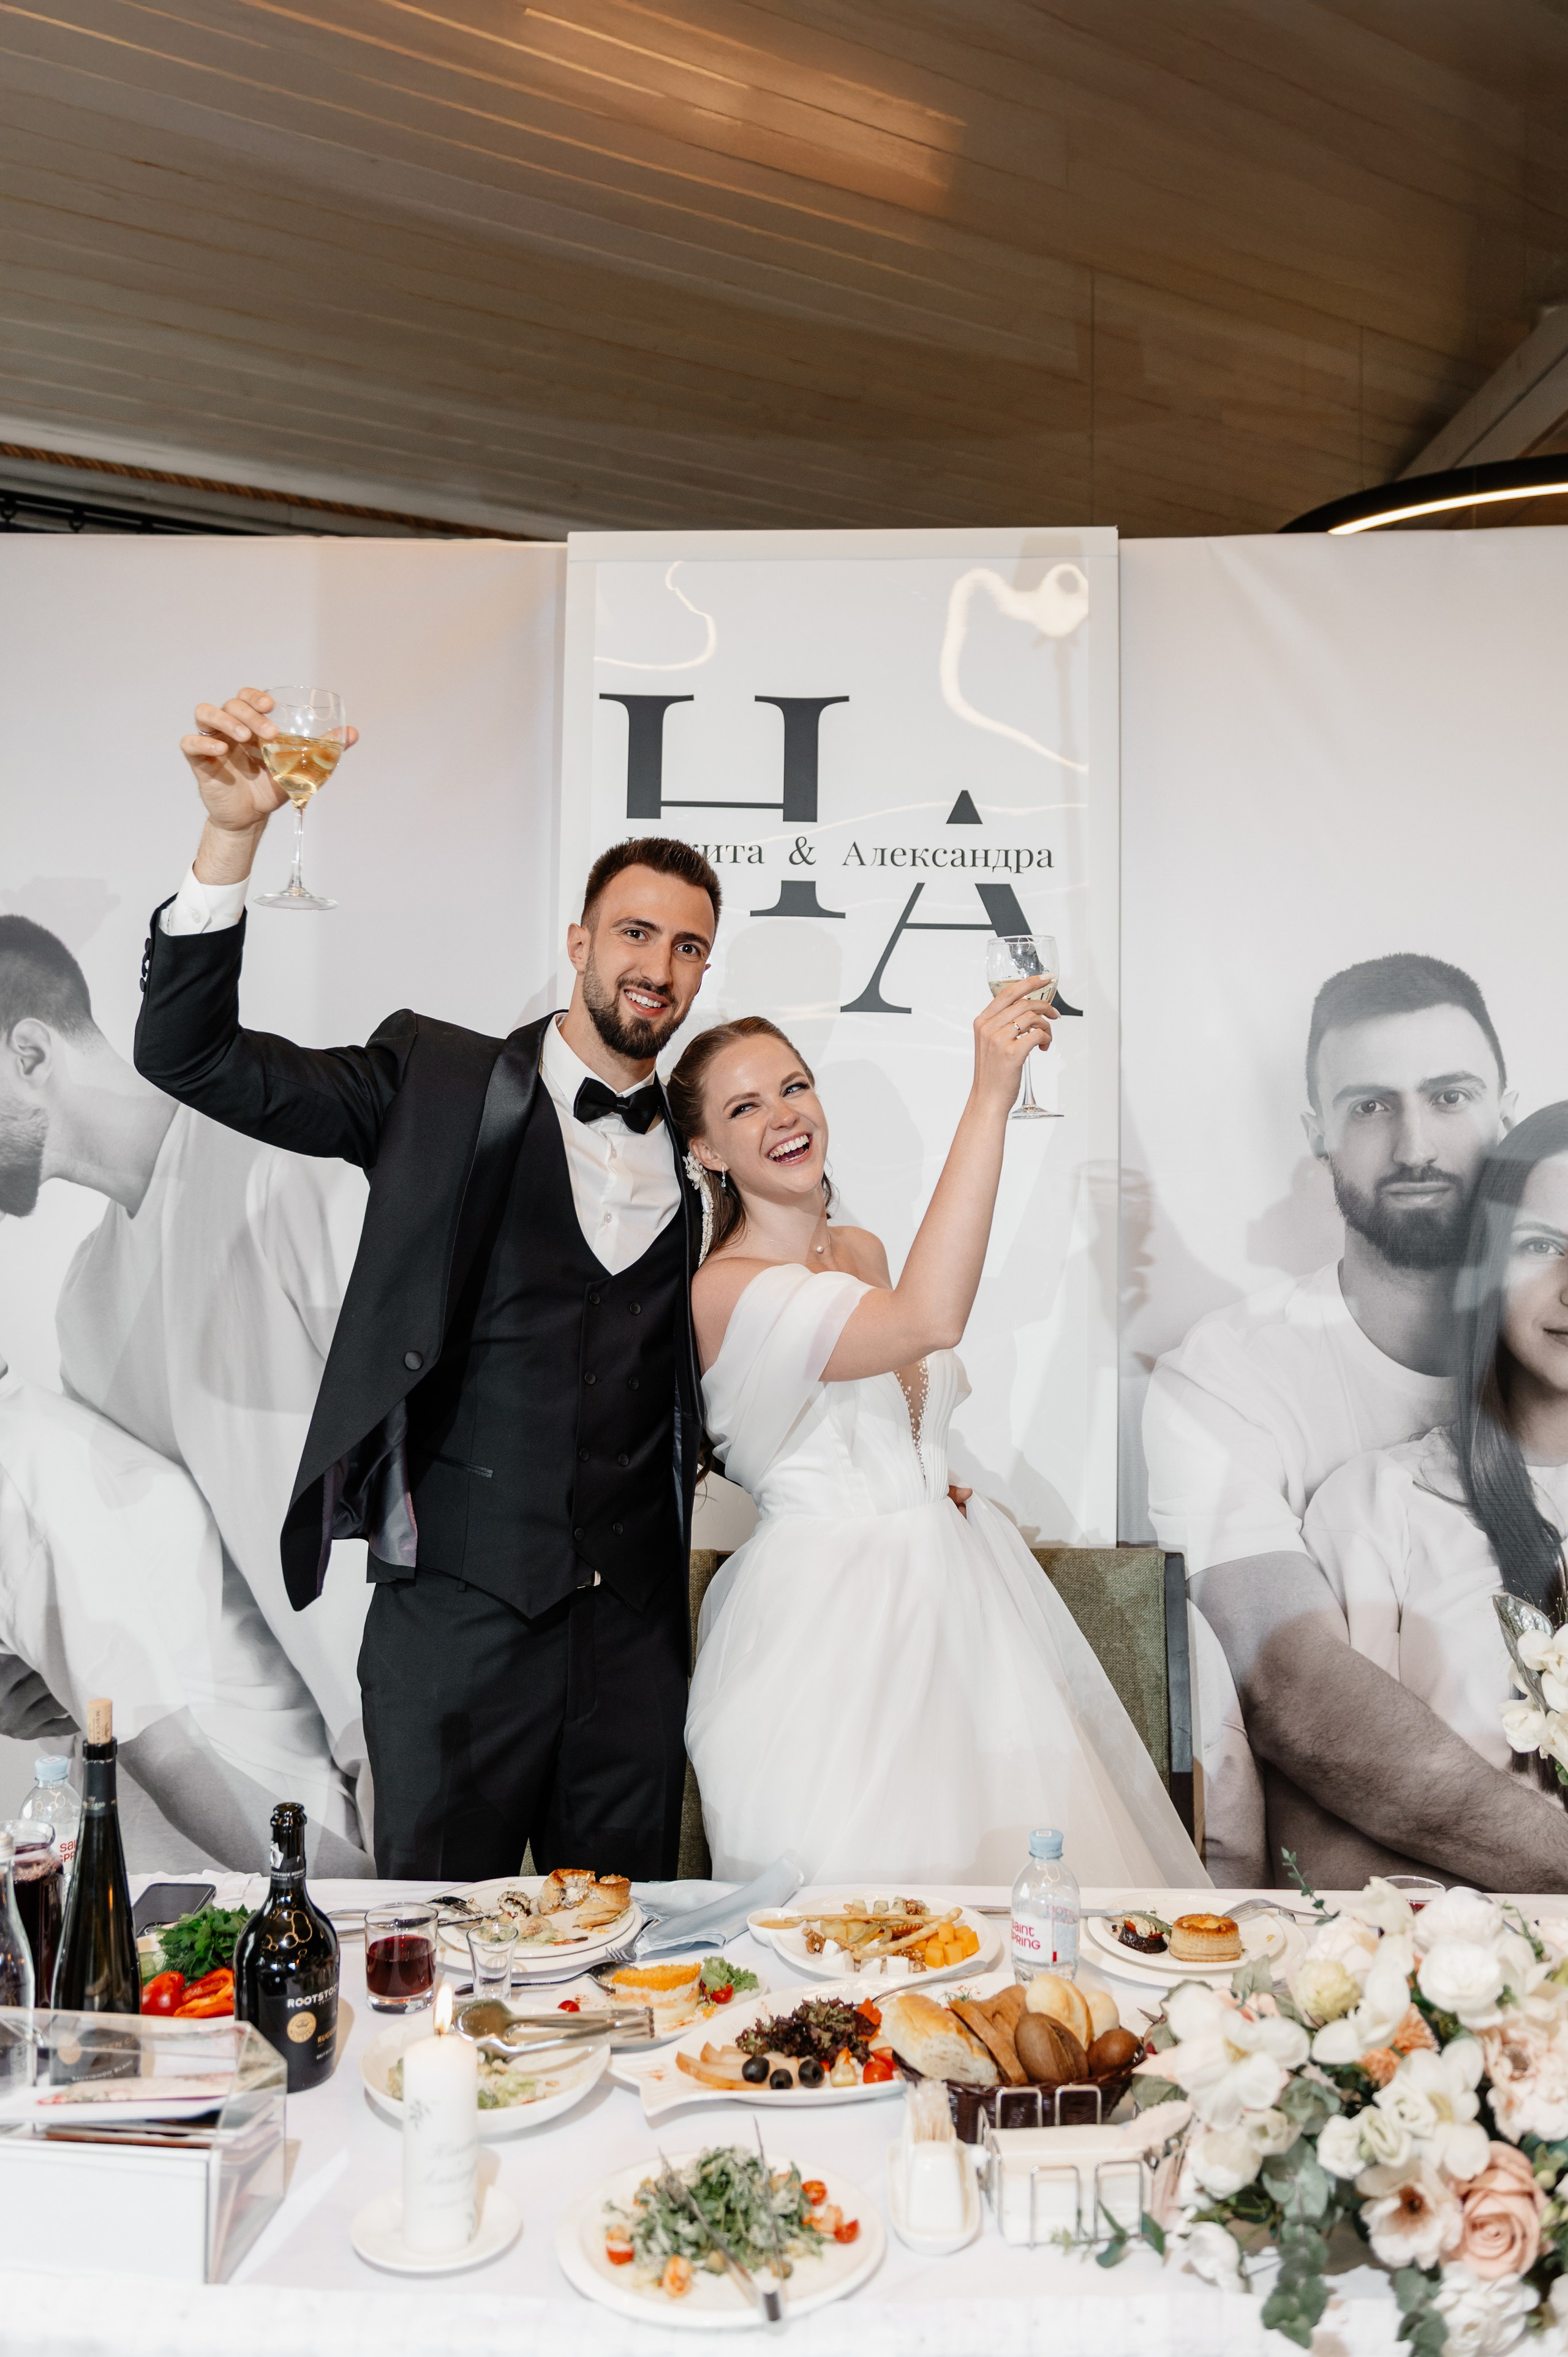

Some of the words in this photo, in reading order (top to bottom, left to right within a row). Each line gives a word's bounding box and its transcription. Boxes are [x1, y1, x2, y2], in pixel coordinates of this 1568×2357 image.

[788, 836, 816, 865] &
[842, 841, 1055, 874] Александра
[840, 790, 1084, 1017] А
